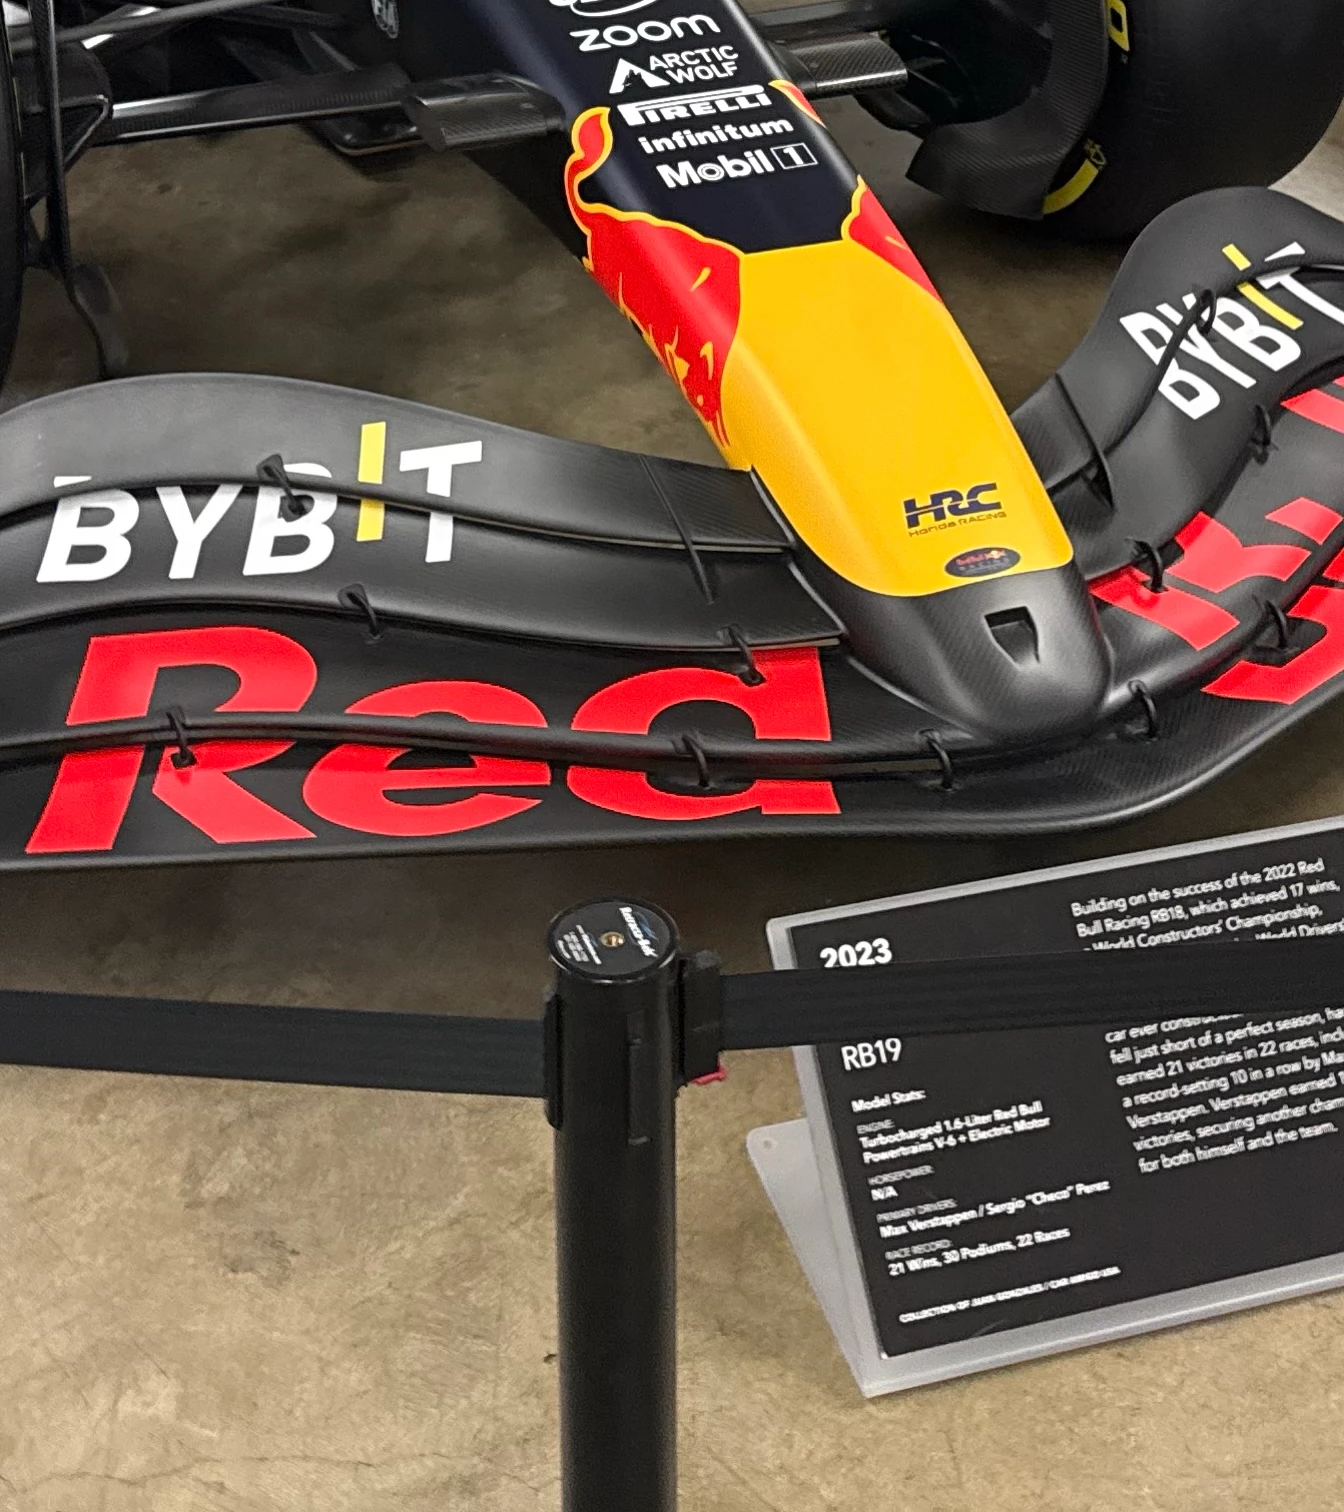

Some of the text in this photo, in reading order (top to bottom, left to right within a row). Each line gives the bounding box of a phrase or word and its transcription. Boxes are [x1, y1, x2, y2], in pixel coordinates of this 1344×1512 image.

[569, 13, 721, 52] zoom
[649, 45, 739, 71] ARCTIC
[665, 61, 739, 84] WOLF
[617, 84, 773, 127] PIRELLI
[638, 117, 794, 154] infinitum
[655, 147, 774, 190] Mobil
[35, 420, 484, 585] BYBIT
[903, 482, 1003, 529] HRC
[908, 521, 957, 538] Honda
[24, 623, 843, 856] Red
[1071, 857, 1325, 917] Building on the success of the 2022 Red
[1076, 920, 1104, 938] Bull
[1104, 914, 1151, 934] Racing
[1189, 898, 1229, 917] which
[1230, 888, 1288, 909] achieved
[1289, 882, 1305, 897] 17
[820, 937, 893, 968] 2023
[1105, 1024, 1158, 1043] car ever
[1109, 1048, 1131, 1064] fell
[1133, 1044, 1159, 1063] just
[1160, 1037, 1196, 1054] short
[1197, 1030, 1213, 1046] of
[1214, 1031, 1224, 1044] a
[1225, 1021, 1274, 1044] perfect
[841, 1038, 902, 1071] RB19
[1116, 1064, 1165, 1086] earned
[1166, 1060, 1183, 1076] 21
[1185, 1048, 1243, 1072] victories
[1244, 1047, 1257, 1061] in
[1258, 1041, 1277, 1057] 22
[1122, 1096, 1133, 1108] a
[1230, 1069, 1248, 1085] 10
[1249, 1067, 1263, 1081] in
[1264, 1066, 1275, 1078] a
[1276, 1061, 1301, 1075] row
[1302, 1055, 1321, 1072] by
[1288, 1073, 1338, 1095] earned
[851, 1093, 891, 1112] Model
[859, 1121, 943, 1149] Turbocharged
[993, 1106, 1018, 1121] Red
[1018, 1100, 1044, 1116] Bull
[1196, 1116, 1256, 1138] securing
[1138, 1157, 1159, 1173] for
[1160, 1149, 1196, 1169] both
[1195, 1136, 1246, 1161] himself
[1247, 1131, 1274, 1150] and
[1274, 1128, 1298, 1144] the
[870, 1185, 898, 1202] N/A
